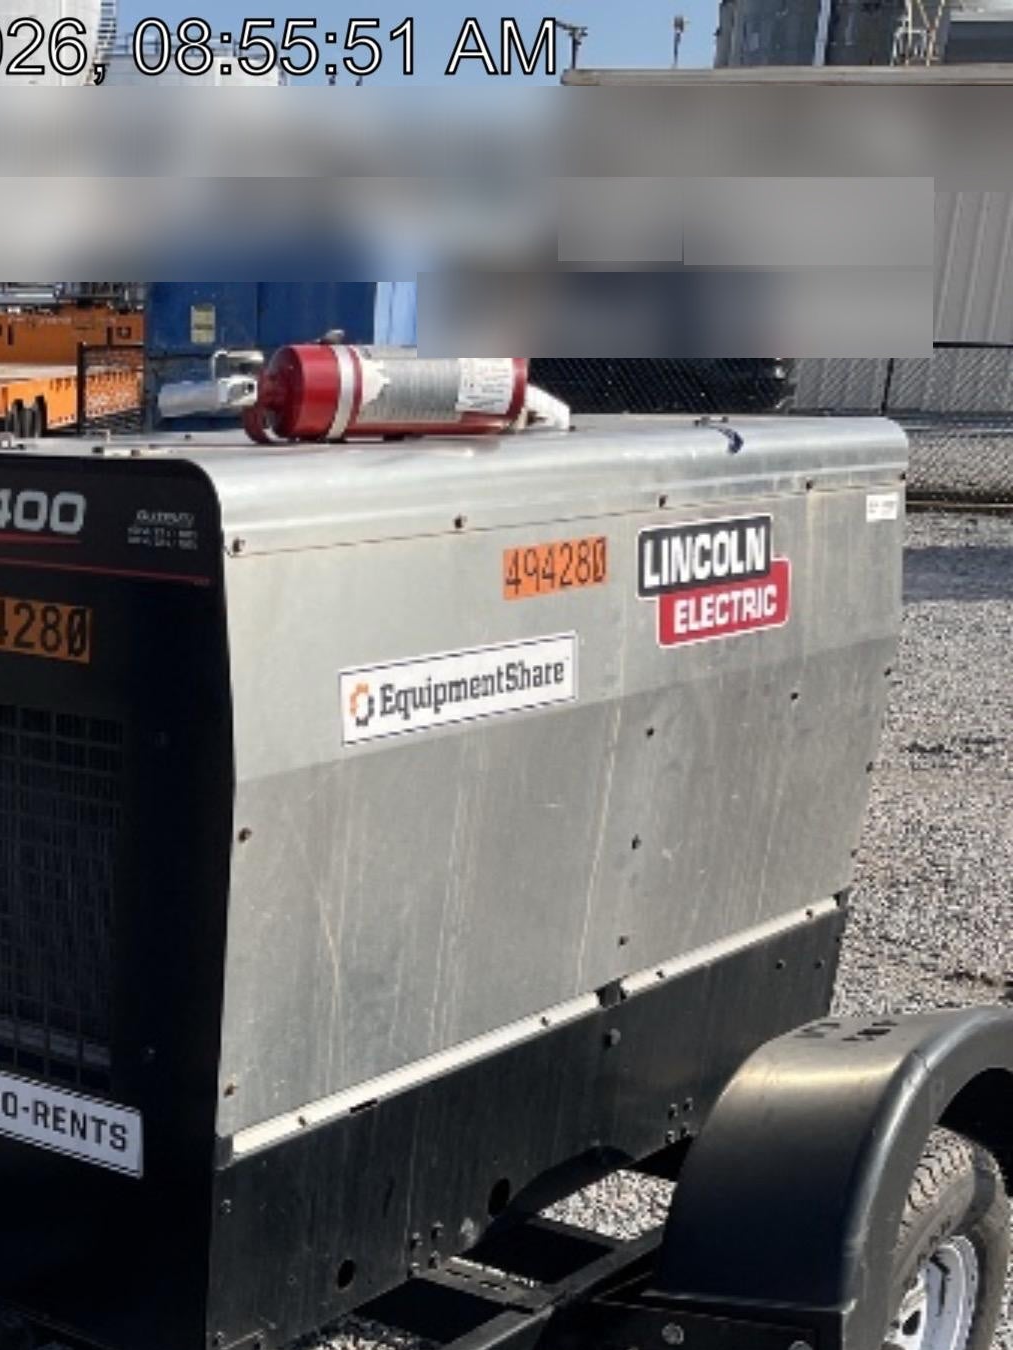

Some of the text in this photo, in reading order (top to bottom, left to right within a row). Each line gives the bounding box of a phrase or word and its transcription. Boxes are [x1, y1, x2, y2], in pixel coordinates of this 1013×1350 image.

[505, 536, 607, 596] 494280
[643, 525, 766, 589] LINCOLN
[673, 584, 778, 635] ELECTRIC
[379, 660, 565, 721] EquipmentShare
